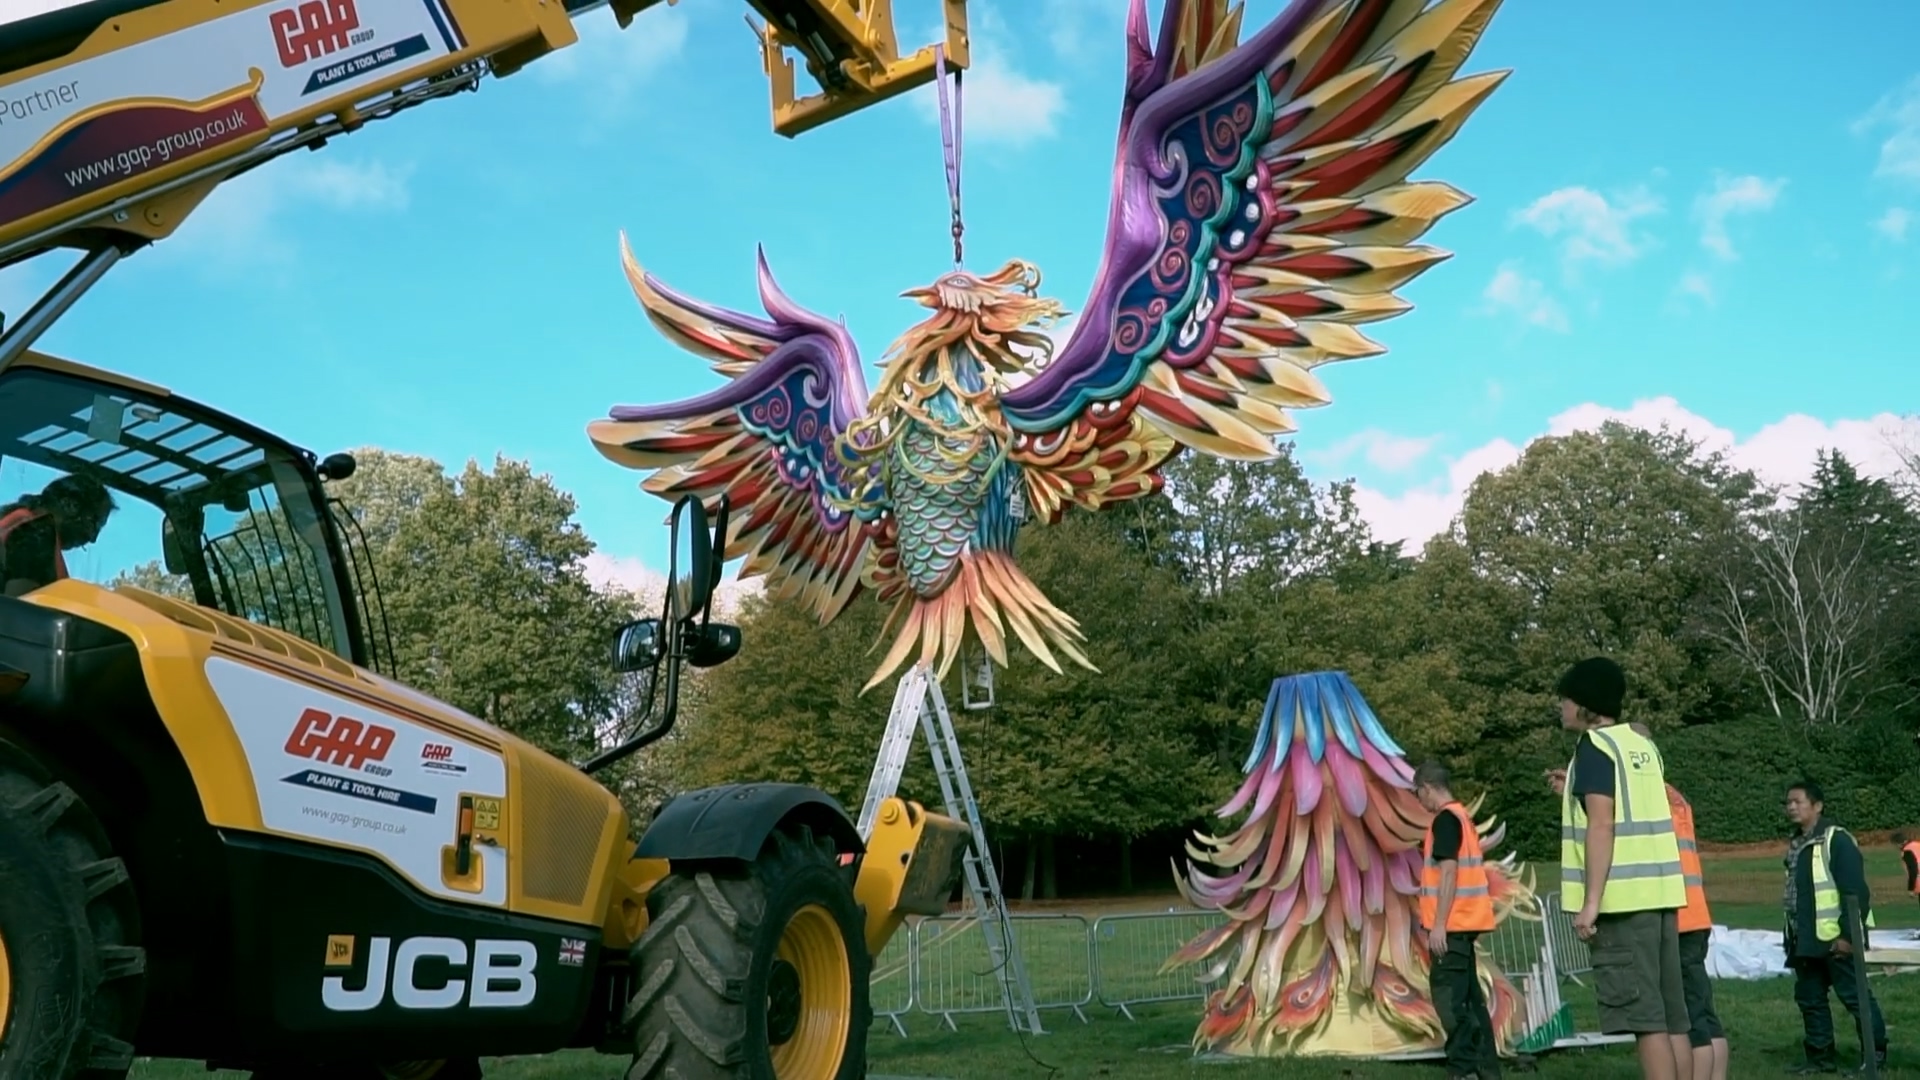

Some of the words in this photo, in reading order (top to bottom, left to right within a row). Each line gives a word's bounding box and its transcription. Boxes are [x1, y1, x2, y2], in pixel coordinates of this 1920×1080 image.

[269, 0, 360, 69] GAP
[350, 28, 375, 46] GROUP
[316, 65, 347, 84] PLANT
[354, 56, 377, 71] TOOL
[376, 47, 397, 63] HIRE
[64, 109, 248, 188] www.gap-group.co.uk
[284, 708, 396, 770] GAP
[306, 772, 342, 790] PLANT
[341, 781, 351, 791] &
[351, 782, 376, 797] TOOL
[376, 788, 401, 802] HIRE
[363, 763, 393, 778] GROUP
[301, 805, 408, 835] www.gap-group.co.uk
[321, 936, 538, 1011] JCB
